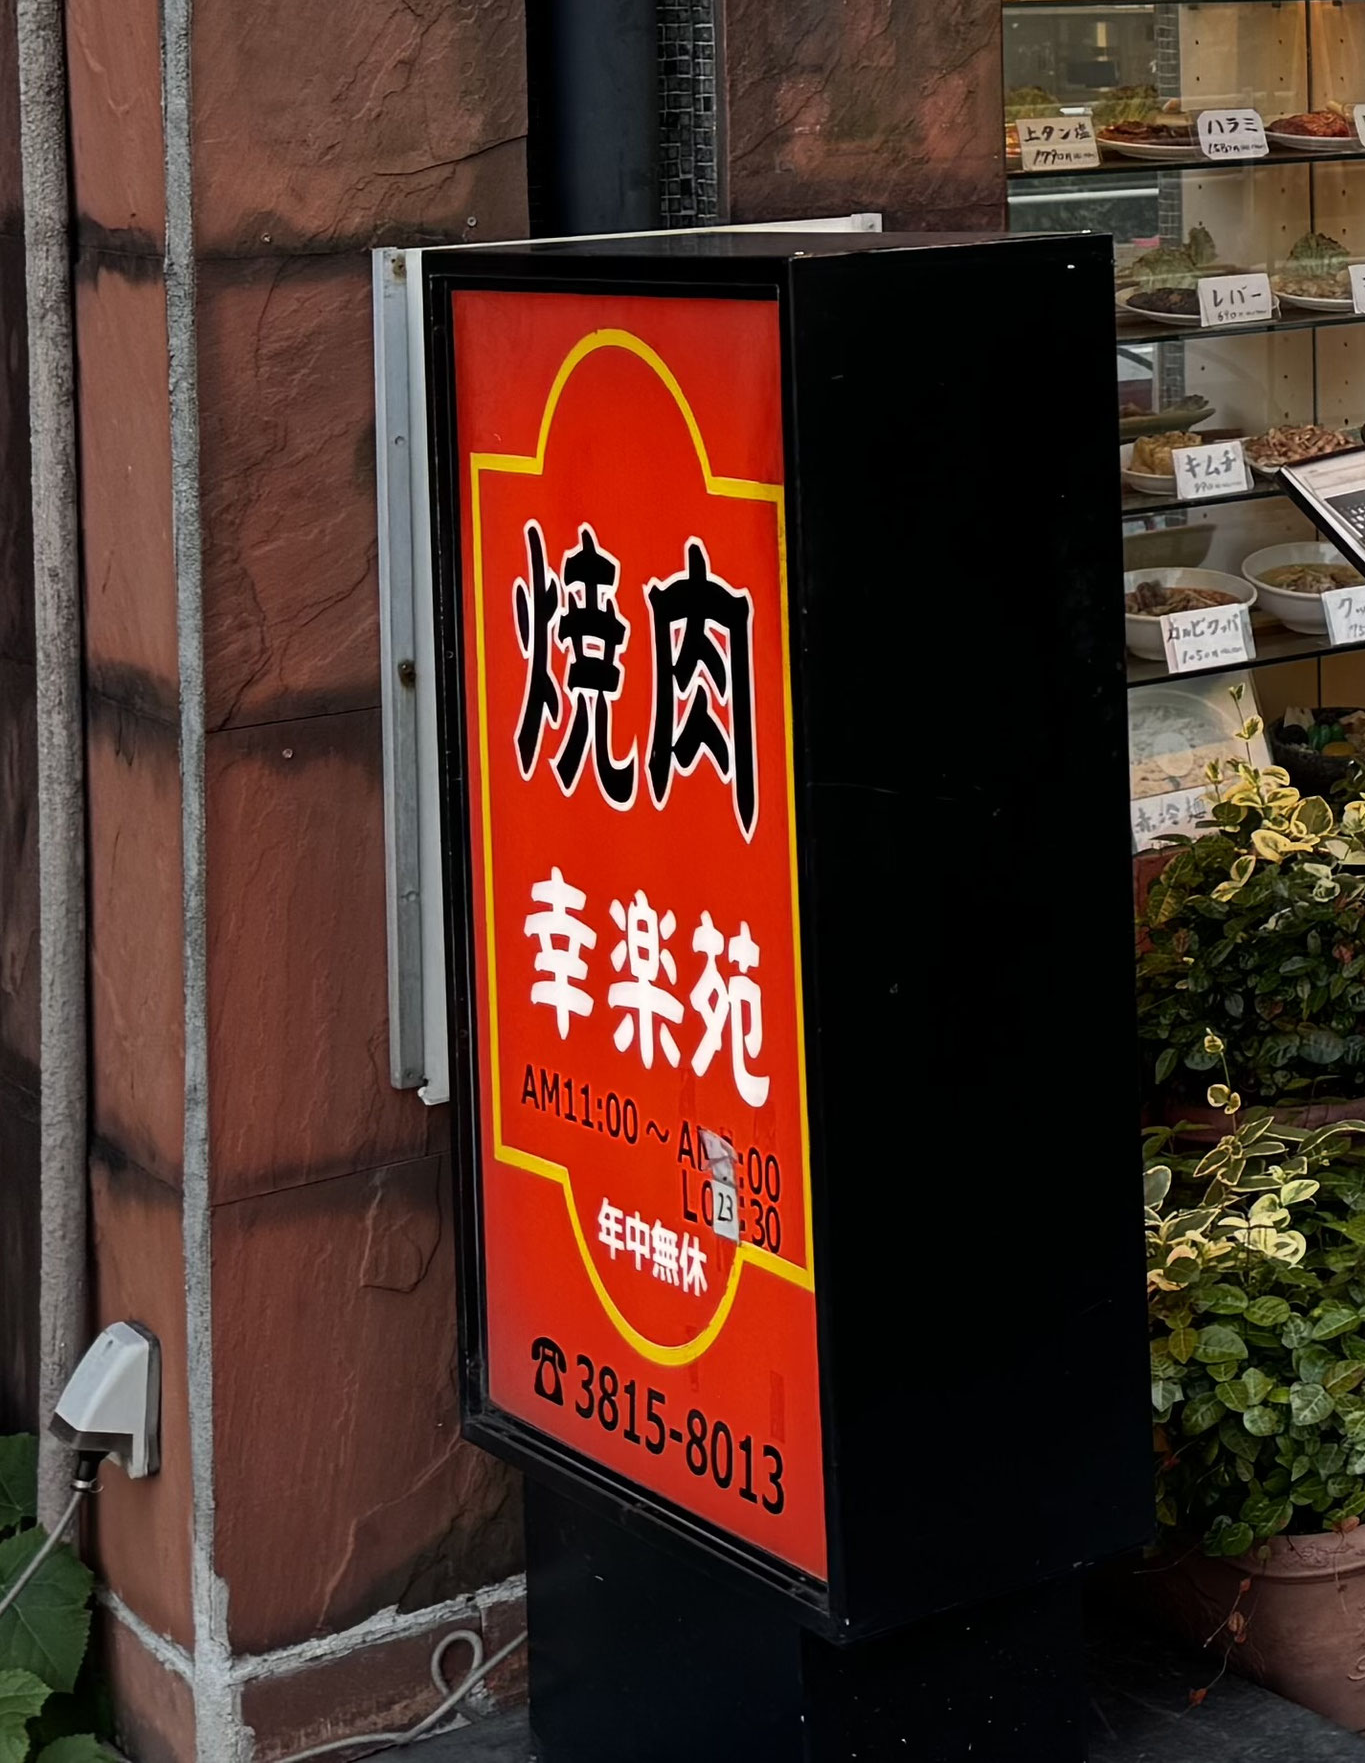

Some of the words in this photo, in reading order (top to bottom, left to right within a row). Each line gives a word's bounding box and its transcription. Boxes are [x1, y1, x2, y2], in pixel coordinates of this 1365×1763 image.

[1207, 117, 1259, 135] ハラミ
[1212, 284, 1262, 308] レバー
[1185, 449, 1238, 479] キムチ
[512, 518, 759, 846] 焼肉
[523, 865, 771, 1109] 幸楽苑
[596, 1195, 708, 1298] 年中無休
[575, 1354, 786, 1516] 3815-8013
